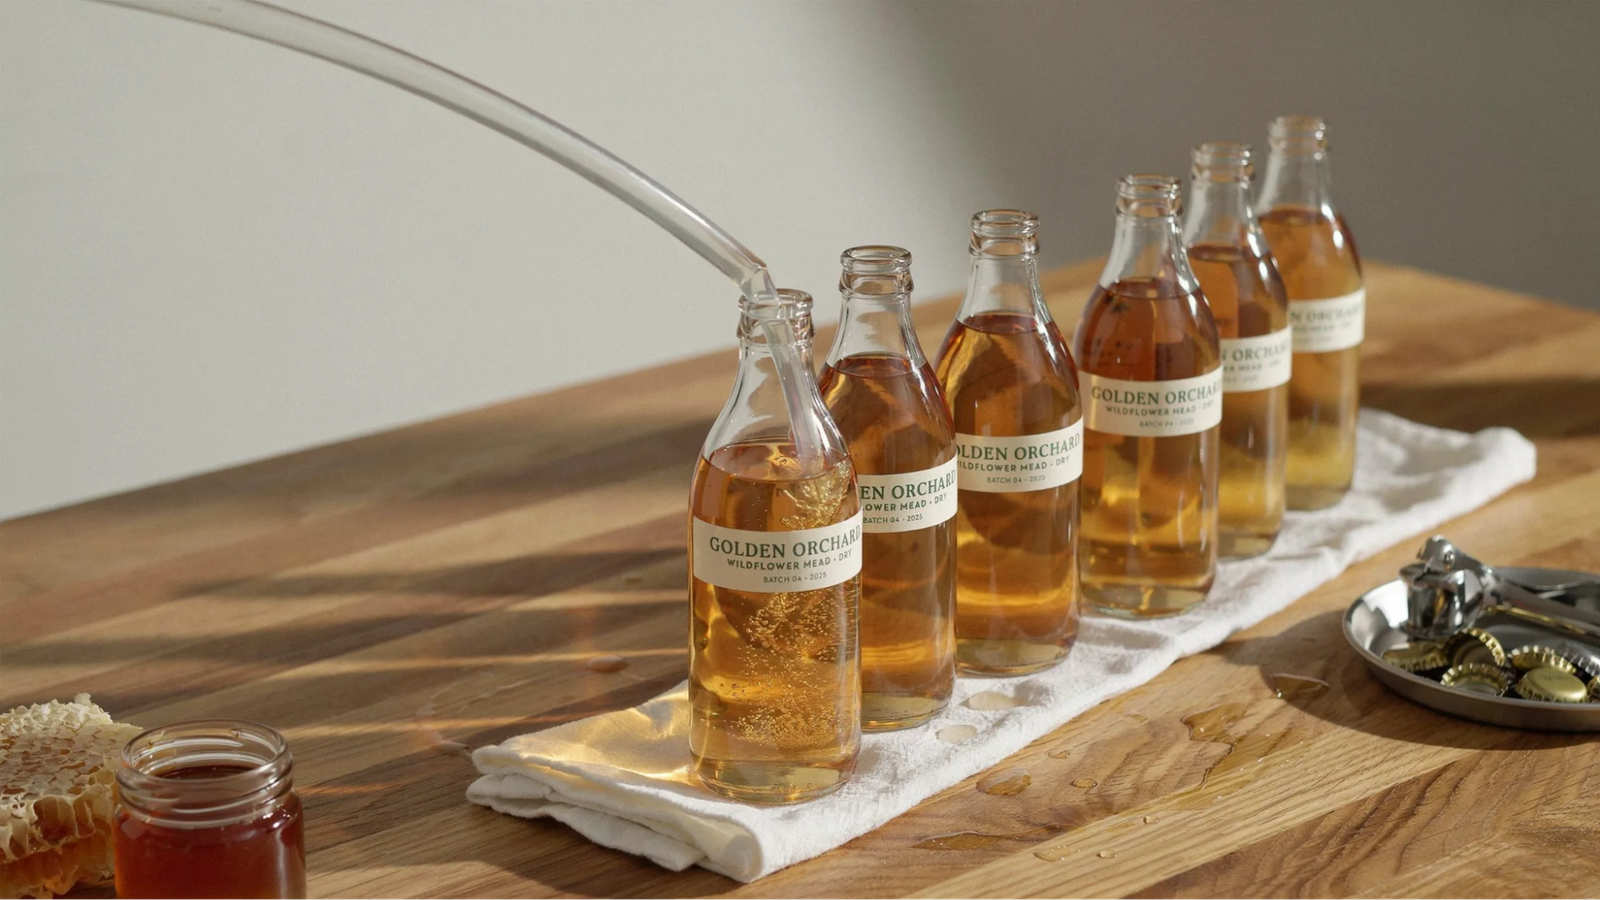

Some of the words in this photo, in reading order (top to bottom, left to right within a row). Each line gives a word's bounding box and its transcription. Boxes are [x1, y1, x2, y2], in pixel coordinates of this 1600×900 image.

[1091, 386, 1159, 405] GOLDEN
[1105, 405, 1169, 417] WILDFLOWER
[1172, 405, 1196, 416] MEAD
[1139, 420, 1163, 428] BATCH
[956, 444, 1008, 461] LDEN
[1014, 433, 1080, 460] ORCHARD
[958, 461, 1017, 472] ILDFLOWER
[1020, 461, 1047, 472] MEAD
[1056, 455, 1070, 467] DRY
[891, 469, 956, 500] ORCHARD
[1012, 476, 1022, 484] 04
[1029, 474, 1046, 483] 2025
[900, 500, 927, 511] MEAD
[934, 492, 947, 504] DRY
[863, 516, 888, 524] BATCH
[906, 513, 923, 521] 2025
[709, 536, 785, 559] GOLDEN
[792, 525, 861, 557] ORCHARD
[727, 558, 800, 571] WILDFLOWER
[803, 558, 831, 569] MEAD
[838, 548, 852, 562] DRY
[763, 576, 790, 584] BATCH
[792, 575, 802, 583] 04
[809, 571, 827, 581] 2025
